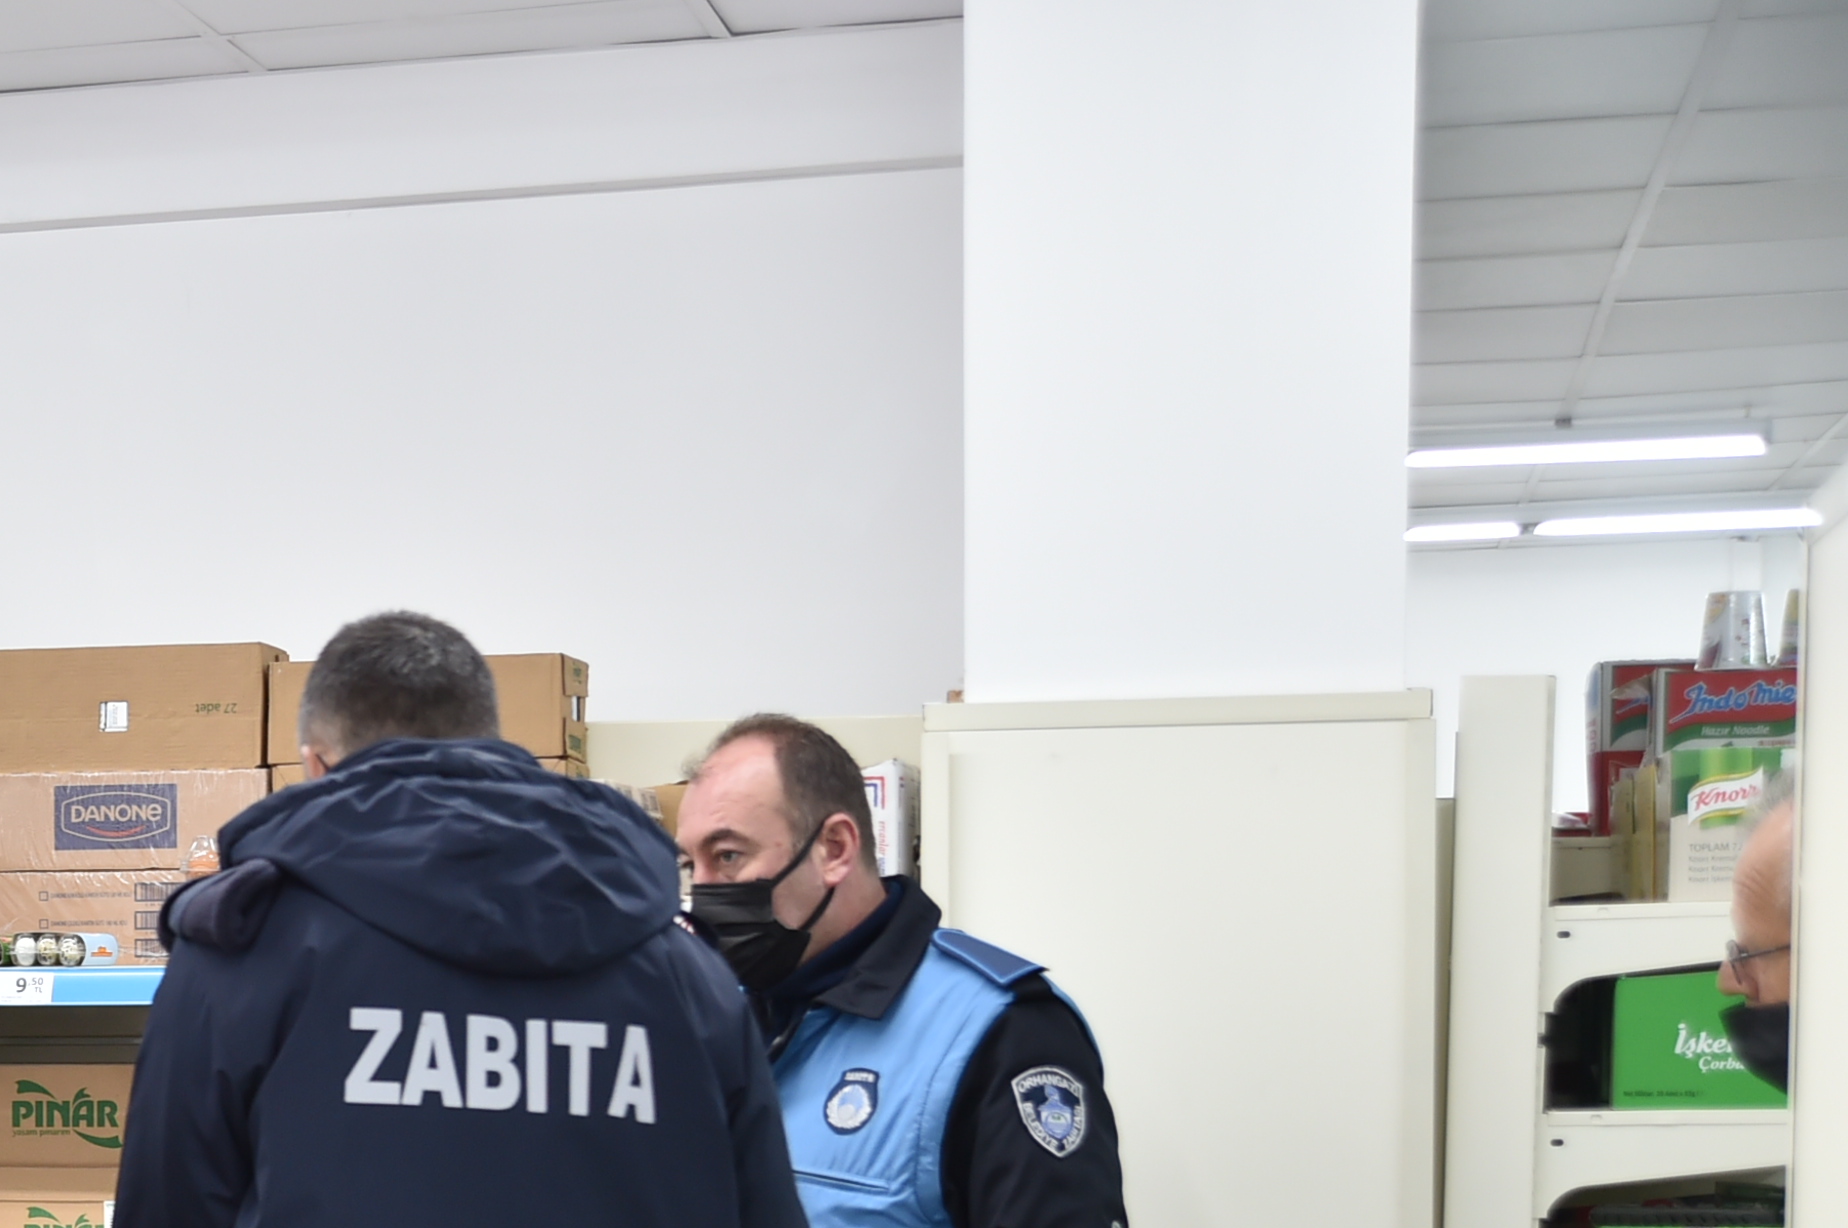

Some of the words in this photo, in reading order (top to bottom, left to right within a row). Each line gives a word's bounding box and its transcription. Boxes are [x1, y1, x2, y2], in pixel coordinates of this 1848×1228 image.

[195, 702, 221, 714] adet
[224, 702, 238, 714] 27
[1733, 725, 1770, 736] Noodle
[1692, 784, 1761, 811] Knorr
[71, 803, 162, 823] DANONE
[344, 1007, 656, 1124] ZABITA
[12, 1101, 119, 1128] PINAR
